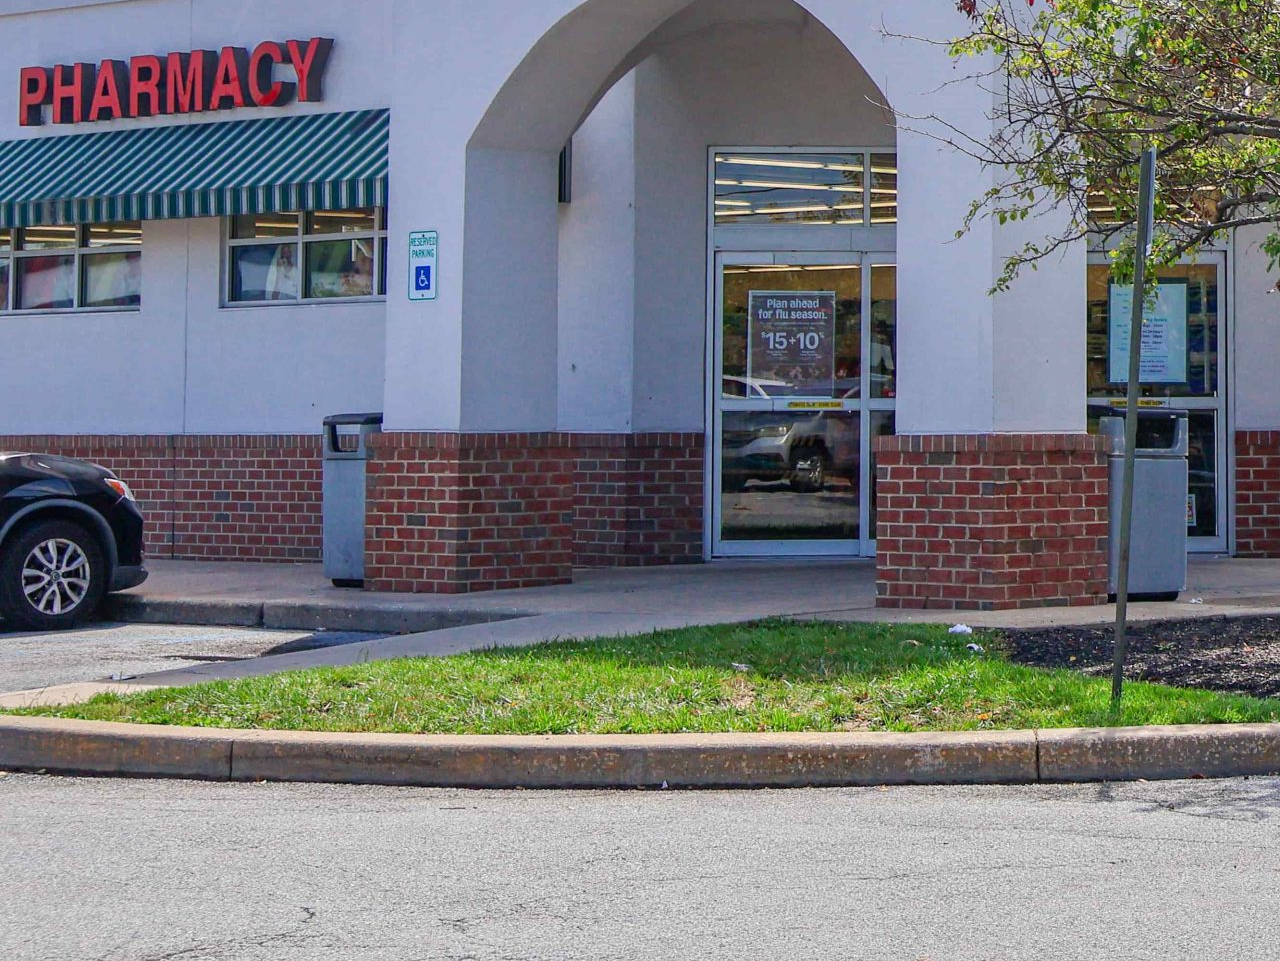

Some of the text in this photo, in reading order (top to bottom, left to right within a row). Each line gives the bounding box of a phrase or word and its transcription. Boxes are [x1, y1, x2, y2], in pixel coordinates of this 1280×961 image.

[19, 37, 334, 126] PHARMACY
[410, 236, 436, 247] RESERVED
[411, 248, 435, 259] PARKING
[766, 298, 820, 309] Plan ahead
[758, 309, 828, 320] for flu season.
